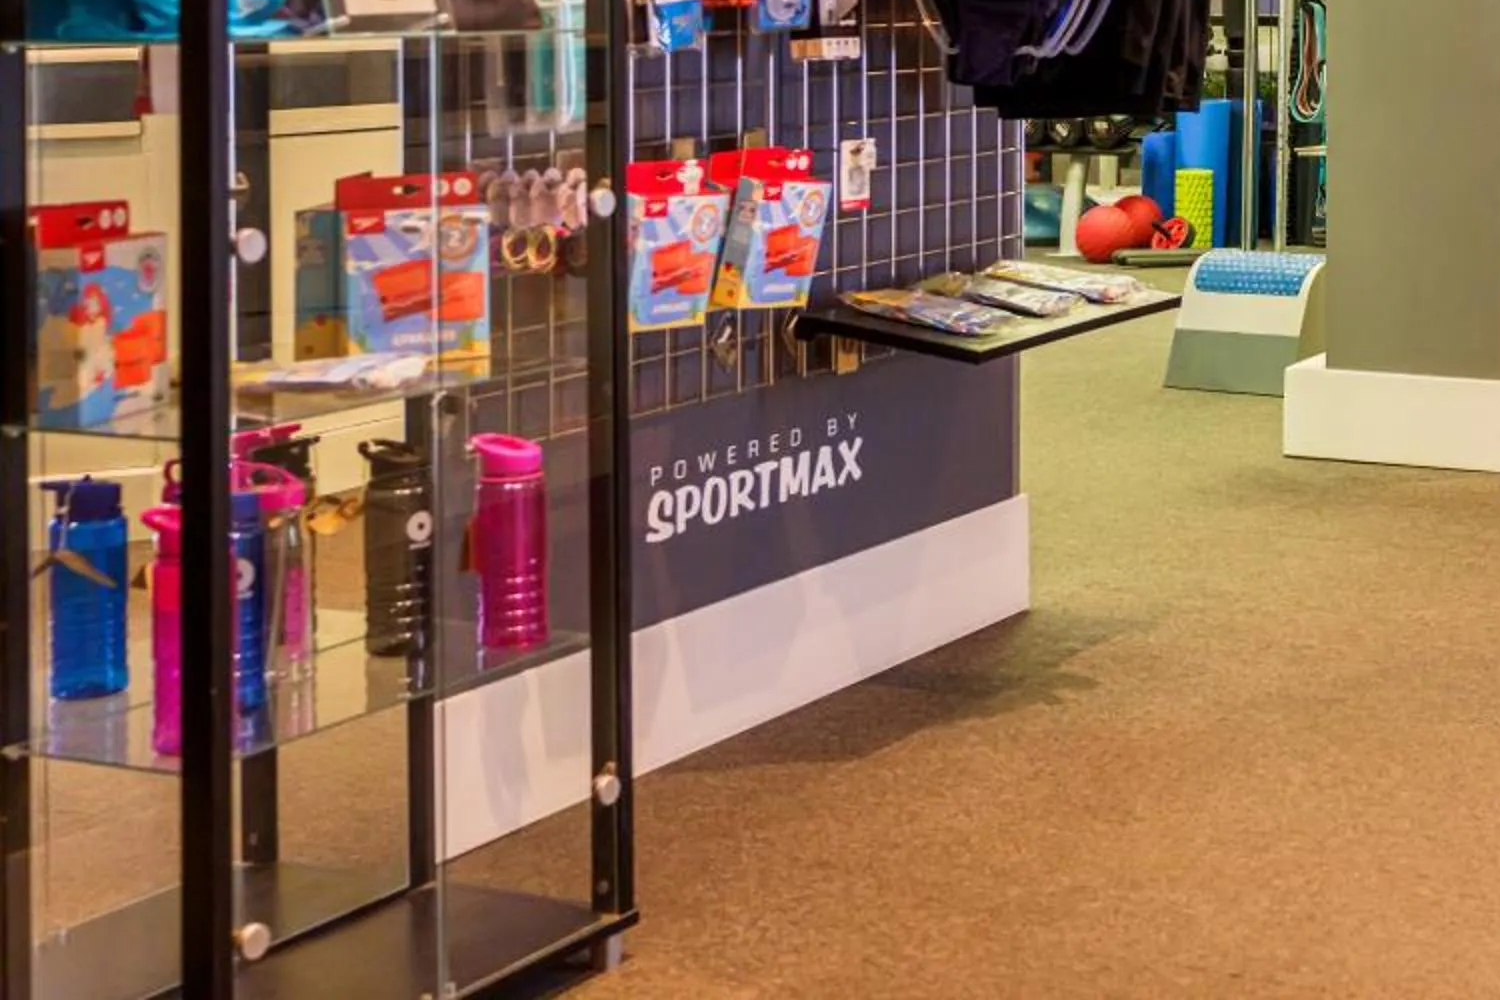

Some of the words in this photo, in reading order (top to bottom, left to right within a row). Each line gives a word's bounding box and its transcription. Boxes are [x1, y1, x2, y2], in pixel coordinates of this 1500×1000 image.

[646, 436, 863, 543] SPORTMAX
[650, 427, 802, 487] POWERED
[826, 412, 858, 438] BY
